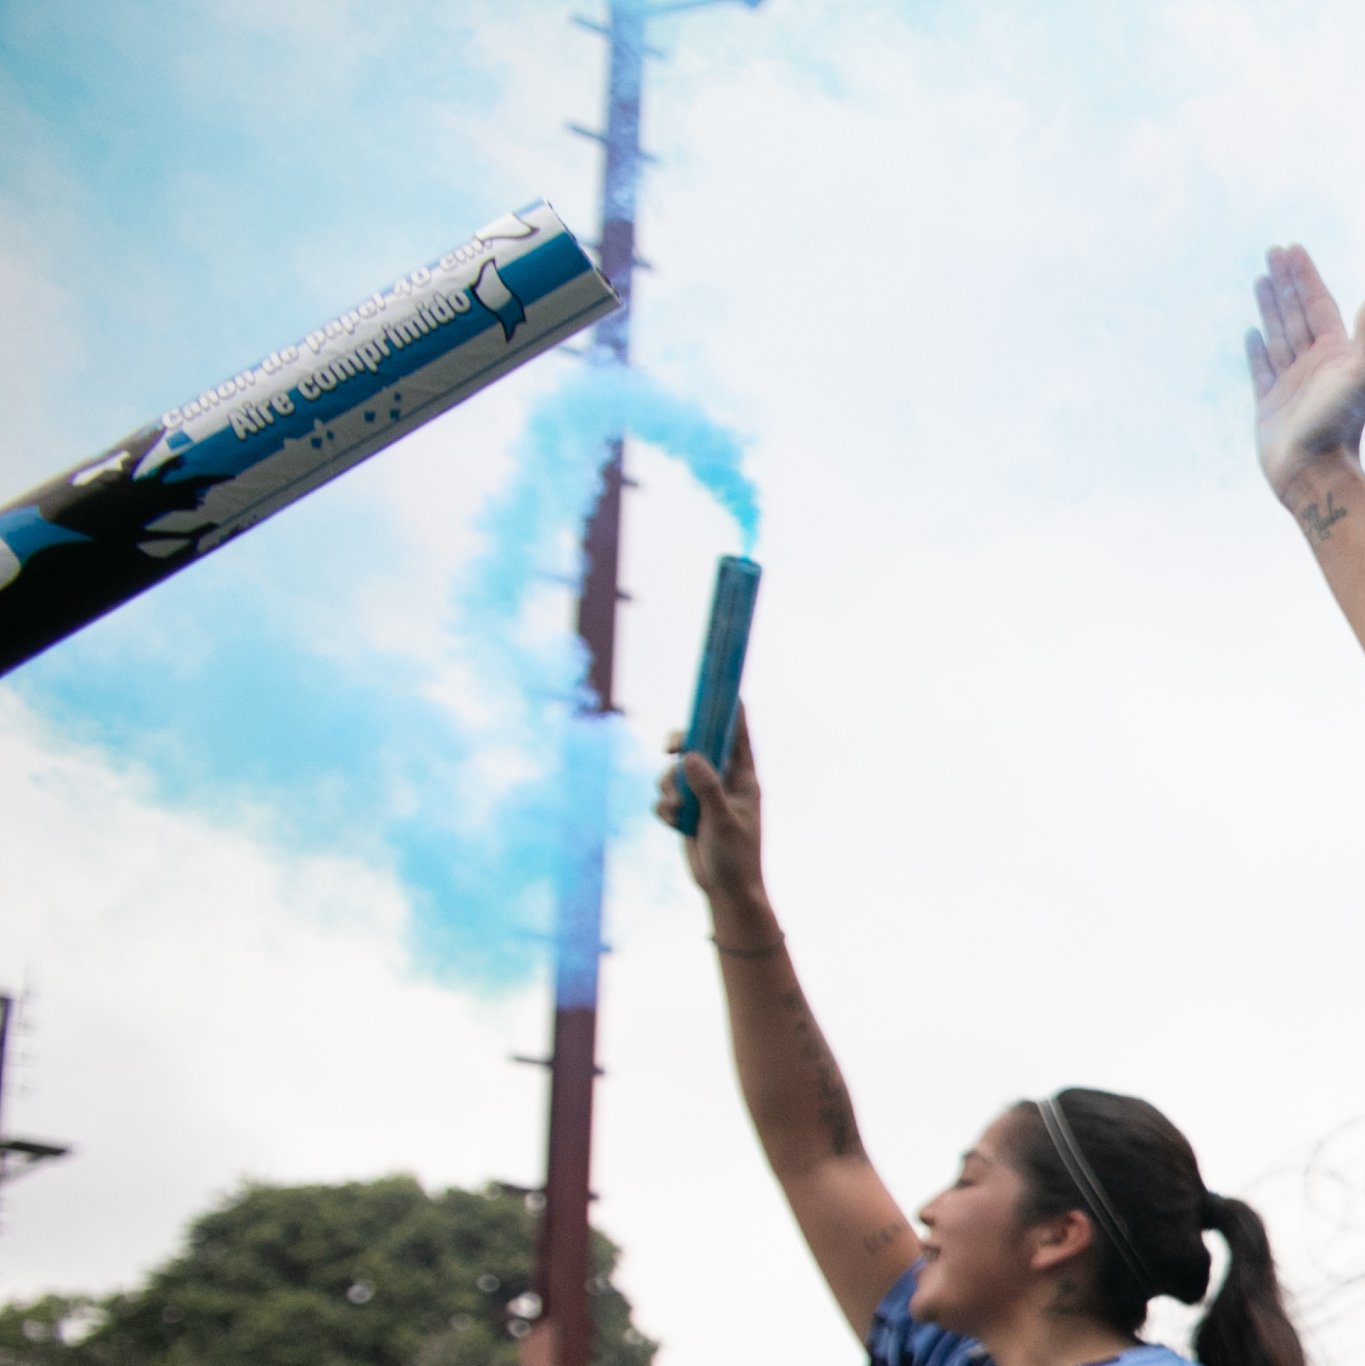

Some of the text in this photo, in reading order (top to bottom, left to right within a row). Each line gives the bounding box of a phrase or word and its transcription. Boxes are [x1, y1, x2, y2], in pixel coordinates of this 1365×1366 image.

[228, 288, 472, 441] Aire comprimido
[305, 291, 386, 353] papel
